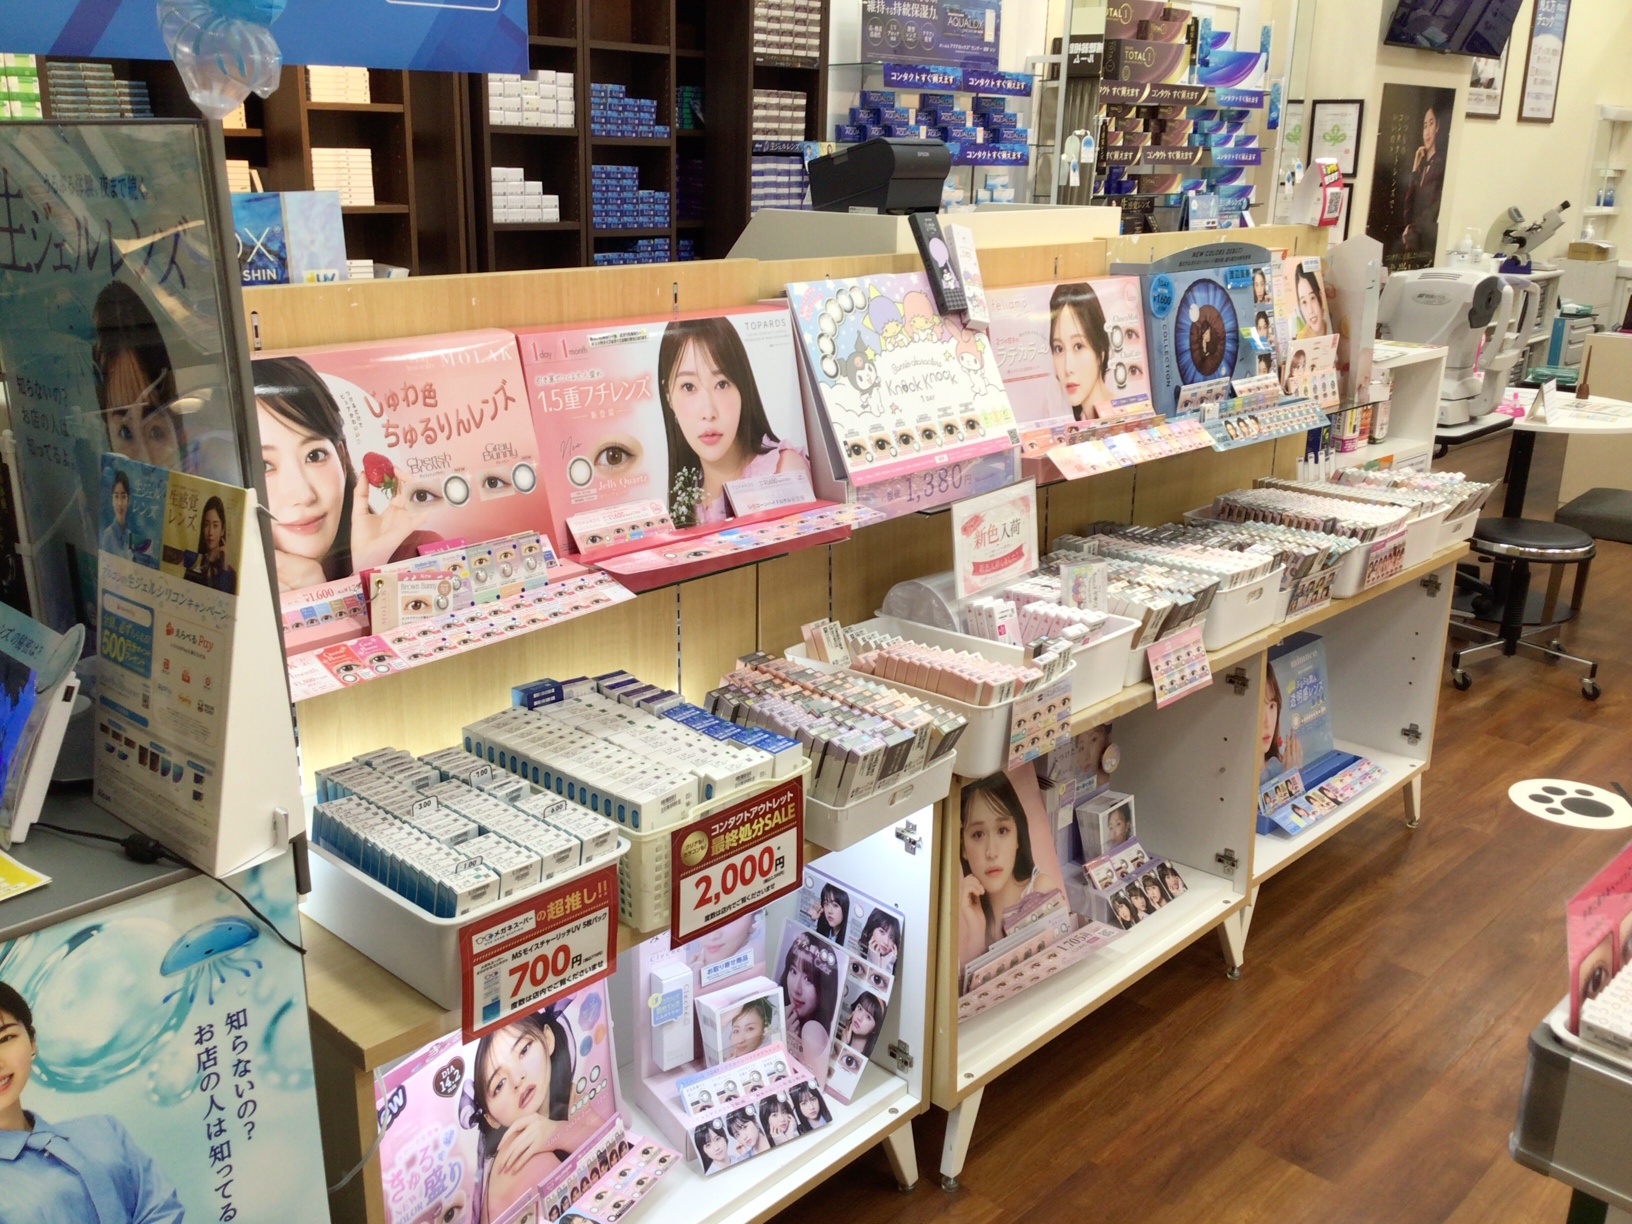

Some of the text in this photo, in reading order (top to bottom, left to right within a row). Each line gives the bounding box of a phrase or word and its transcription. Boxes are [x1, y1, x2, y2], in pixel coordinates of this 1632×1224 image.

[947, 16, 984, 29] AQUALOX
[890, 72, 954, 84] コンタクトすぐ買えます
[968, 77, 1026, 90] コンタクトすぐ買えます
[1112, 87, 1140, 97] すぐ買えます
[1152, 89, 1199, 99] コンタクト すぐ買えます
[966, 150, 1021, 160] コンタクトすぐ買えます
[1147, 151, 1193, 160] コンタクト すぐ買えます
[1205, 249, 1225, 257] COLORS
[745, 319, 786, 330] TOPARDS
[440, 347, 512, 366] MOLAK
[1162, 325, 1171, 388] COLLECTION
[885, 370, 958, 396] Knock Knock
[363, 381, 439, 419] じゅわ色
[537, 376, 651, 413] 1.5重フチレンズ
[382, 379, 516, 448] ちゅるりんレンズ
[590, 409, 614, 419] 新登場
[482, 449, 518, 462] Bunny
[484, 442, 512, 453] Gray
[406, 452, 452, 468] Cherish
[410, 460, 451, 474] Brown
[598, 475, 648, 490] Jelly Quartz
[132, 500, 160, 518] レンズ
[169, 489, 199, 512] 生感覚
[168, 510, 197, 531] レンズ
[974, 518, 1021, 549] 新色入荷
[421, 582, 437, 590] Bunny
[175, 628, 197, 644] えらべる
[198, 635, 214, 652] Pay
[711, 791, 793, 836] コンタクトアウトレット
[711, 802, 796, 856] 最終処分SALE
[704, 883, 775, 922] 度数は店内でご覧くださいませ
[511, 912, 608, 961] MSモイスチャーリッチUV 5枚パック
[707, 954, 748, 975] お取り寄せ商品
[510, 960, 605, 1011] 度数は店内でご覧くださいませ
[225, 1007, 258, 1141] 知らないの?
[439, 1069, 461, 1093] 14.2
[441, 1065, 455, 1078] DIA
[193, 1024, 238, 1223] お店の人は知ってる
